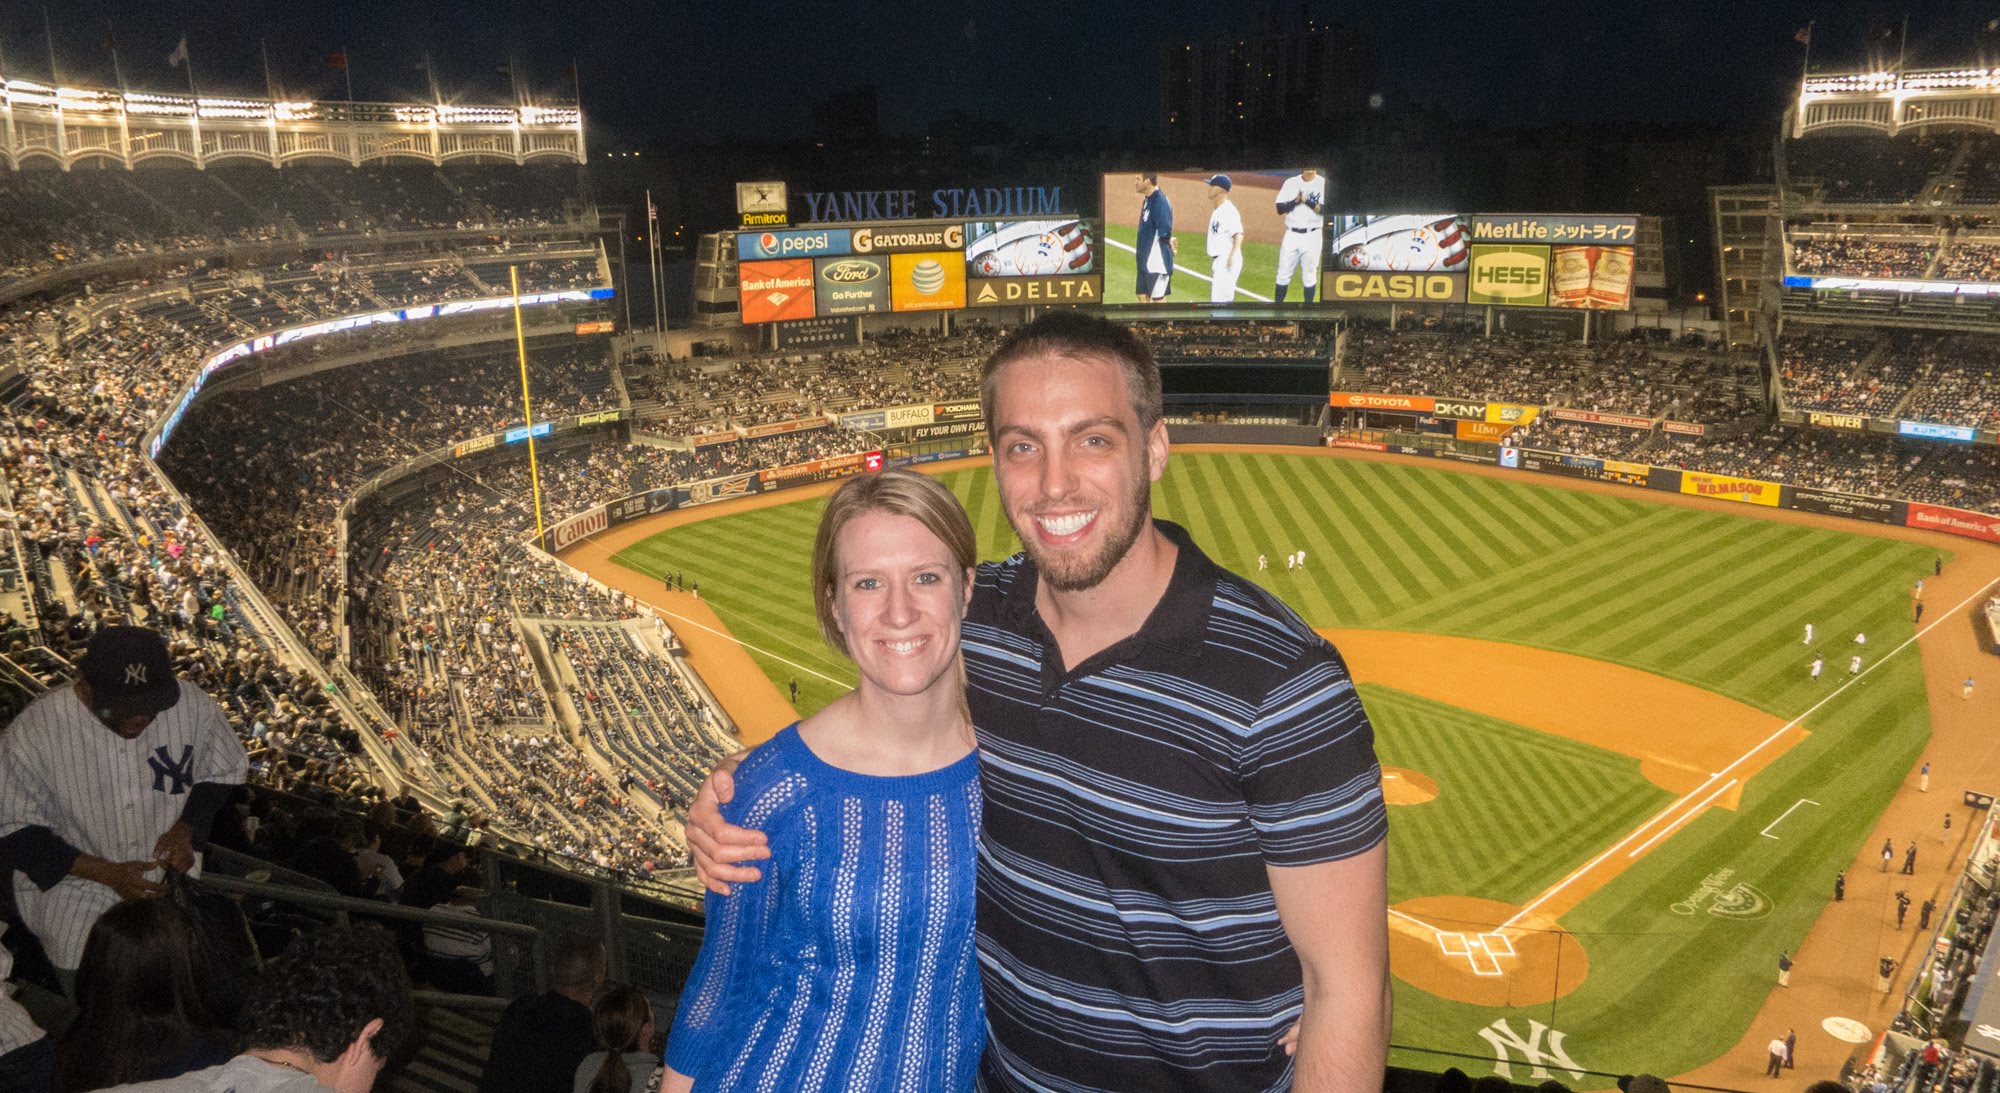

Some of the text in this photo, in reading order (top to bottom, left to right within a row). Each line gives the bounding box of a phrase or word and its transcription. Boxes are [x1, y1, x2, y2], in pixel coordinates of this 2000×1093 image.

[803, 190, 917, 223] YANKEE
[933, 187, 1061, 217] STADIUM
[743, 213, 787, 225] Armitron
[1474, 220, 1635, 240] MetLife メットライフ
[782, 233, 828, 254] pepsi
[873, 233, 942, 247] GATORADE
[834, 263, 869, 281] Ford
[1477, 266, 1541, 284] HESS
[742, 277, 811, 291] Bank of America
[1006, 281, 1094, 299] DELTA
[1335, 274, 1453, 299] CASIO
[845, 290, 872, 299] Further
[944, 404, 980, 413] YOKOHAMA
[1367, 397, 1411, 407] TOYOTA
[1435, 403, 1486, 417] DKNY
[890, 408, 929, 421] BUFFALO
[1501, 409, 1520, 420] SAP
[1810, 413, 1861, 429] PWER
[514, 427, 540, 438] KUMN
[916, 422, 985, 437] FLY YOUR OWN FLAG
[461, 436, 495, 452] SYRACUSE
[1796, 492, 1879, 509] SPIDER-MAN
[556, 511, 606, 547] Canon
[1917, 512, 1987, 532] Bank of America
[125, 663, 147, 684] NY
[147, 745, 194, 795] NY
[1478, 1018, 1588, 1081] NY
